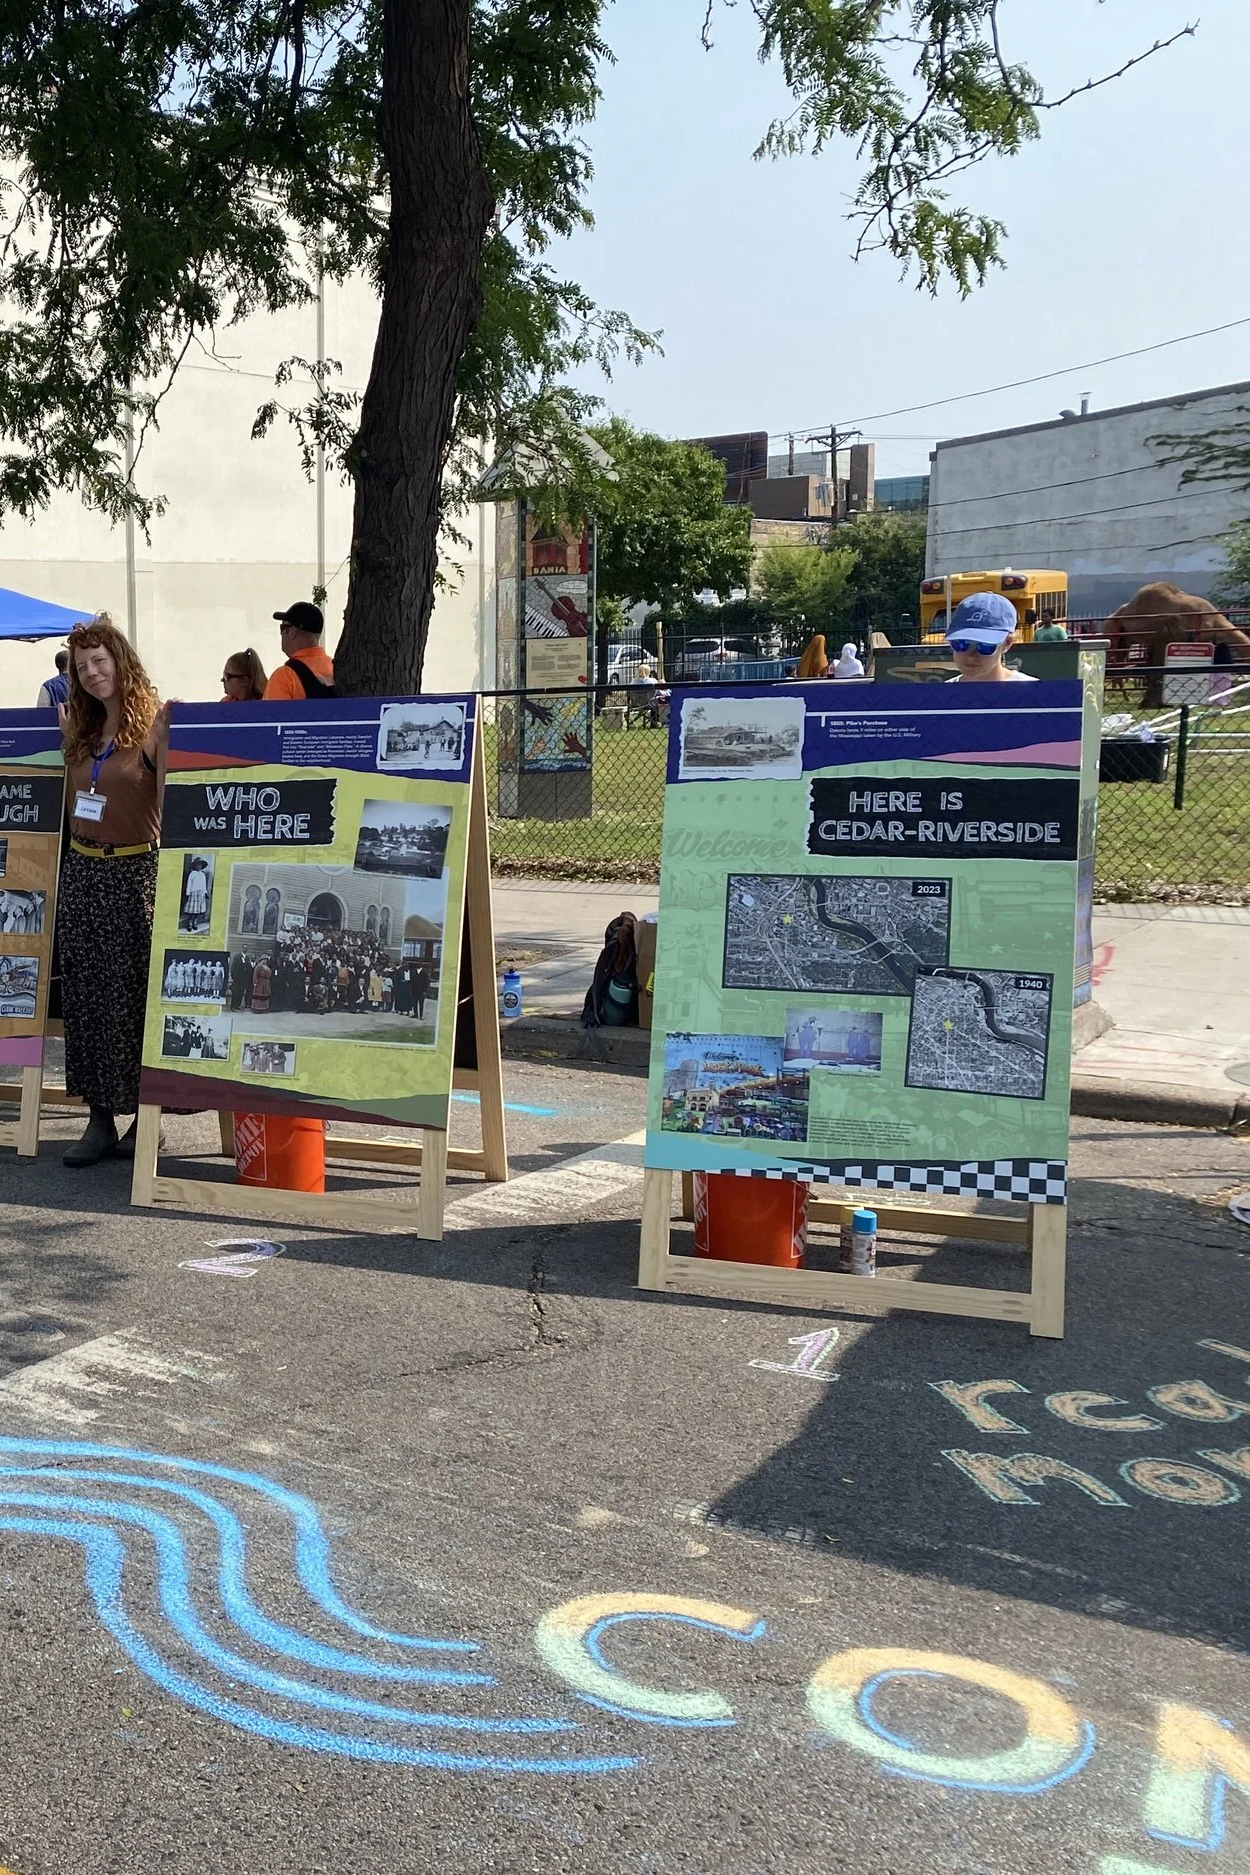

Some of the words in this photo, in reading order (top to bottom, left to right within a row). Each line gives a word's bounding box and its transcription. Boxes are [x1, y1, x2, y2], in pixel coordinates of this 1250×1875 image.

[533, 566, 566, 575] DANIA
[205, 786, 280, 812] WHO
[849, 791, 923, 814] HERE
[941, 791, 964, 812] IS
[194, 816, 227, 831] WAS
[233, 813, 311, 840] HERE
[818, 819, 1061, 844] CEDAR-RIVERSIDE
[917, 886, 941, 894] 2023
[1019, 980, 1043, 988] 1940
[235, 1113, 264, 1158] OME
[238, 1138, 266, 1176] DEPOT
[177, 1238, 287, 1278] 2
[749, 1327, 841, 1382] 1
